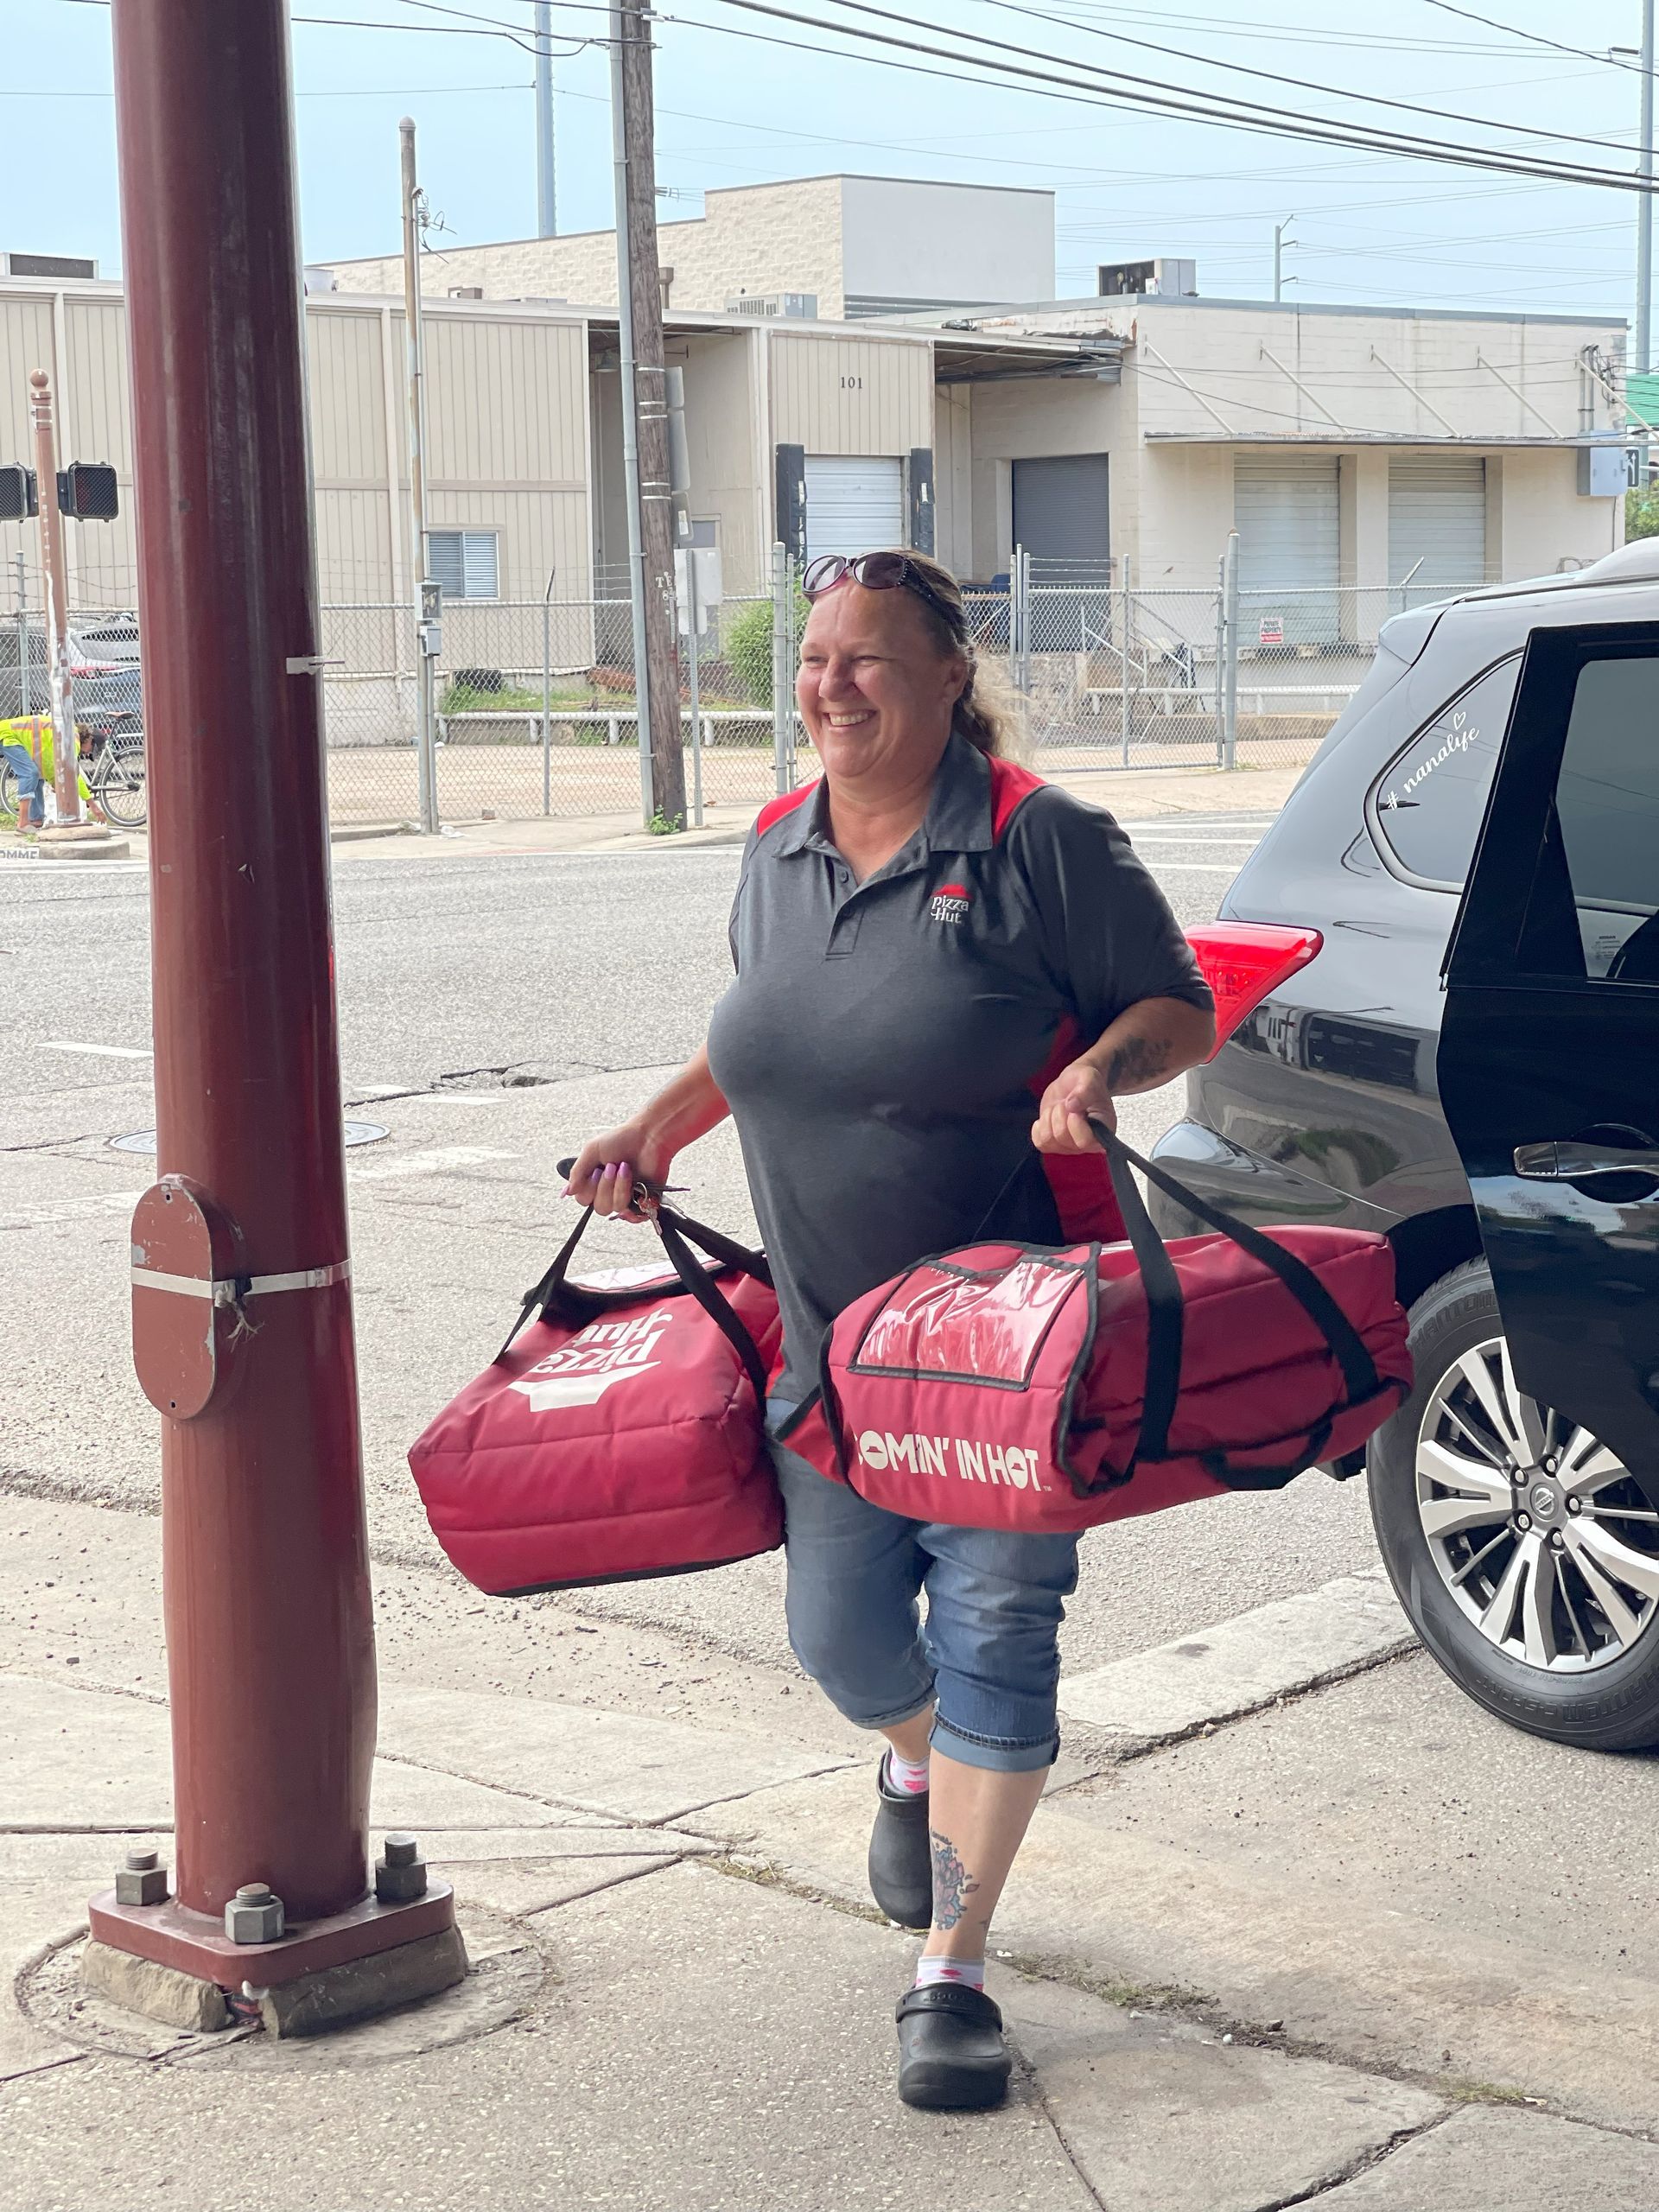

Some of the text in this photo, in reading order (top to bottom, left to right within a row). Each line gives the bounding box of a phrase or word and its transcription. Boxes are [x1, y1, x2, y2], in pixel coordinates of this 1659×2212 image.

[841, 377, 862, 389] 101
[931, 895, 969, 912] Pizza
[931, 907, 962, 924] Hut
[571, 1307, 673, 1347] Hut
[529, 1329, 665, 1373] Pizza
[854, 1430, 949, 1477] OMIN'
[955, 1439, 987, 1483] IN
[985, 1444, 1042, 1491] HOT
